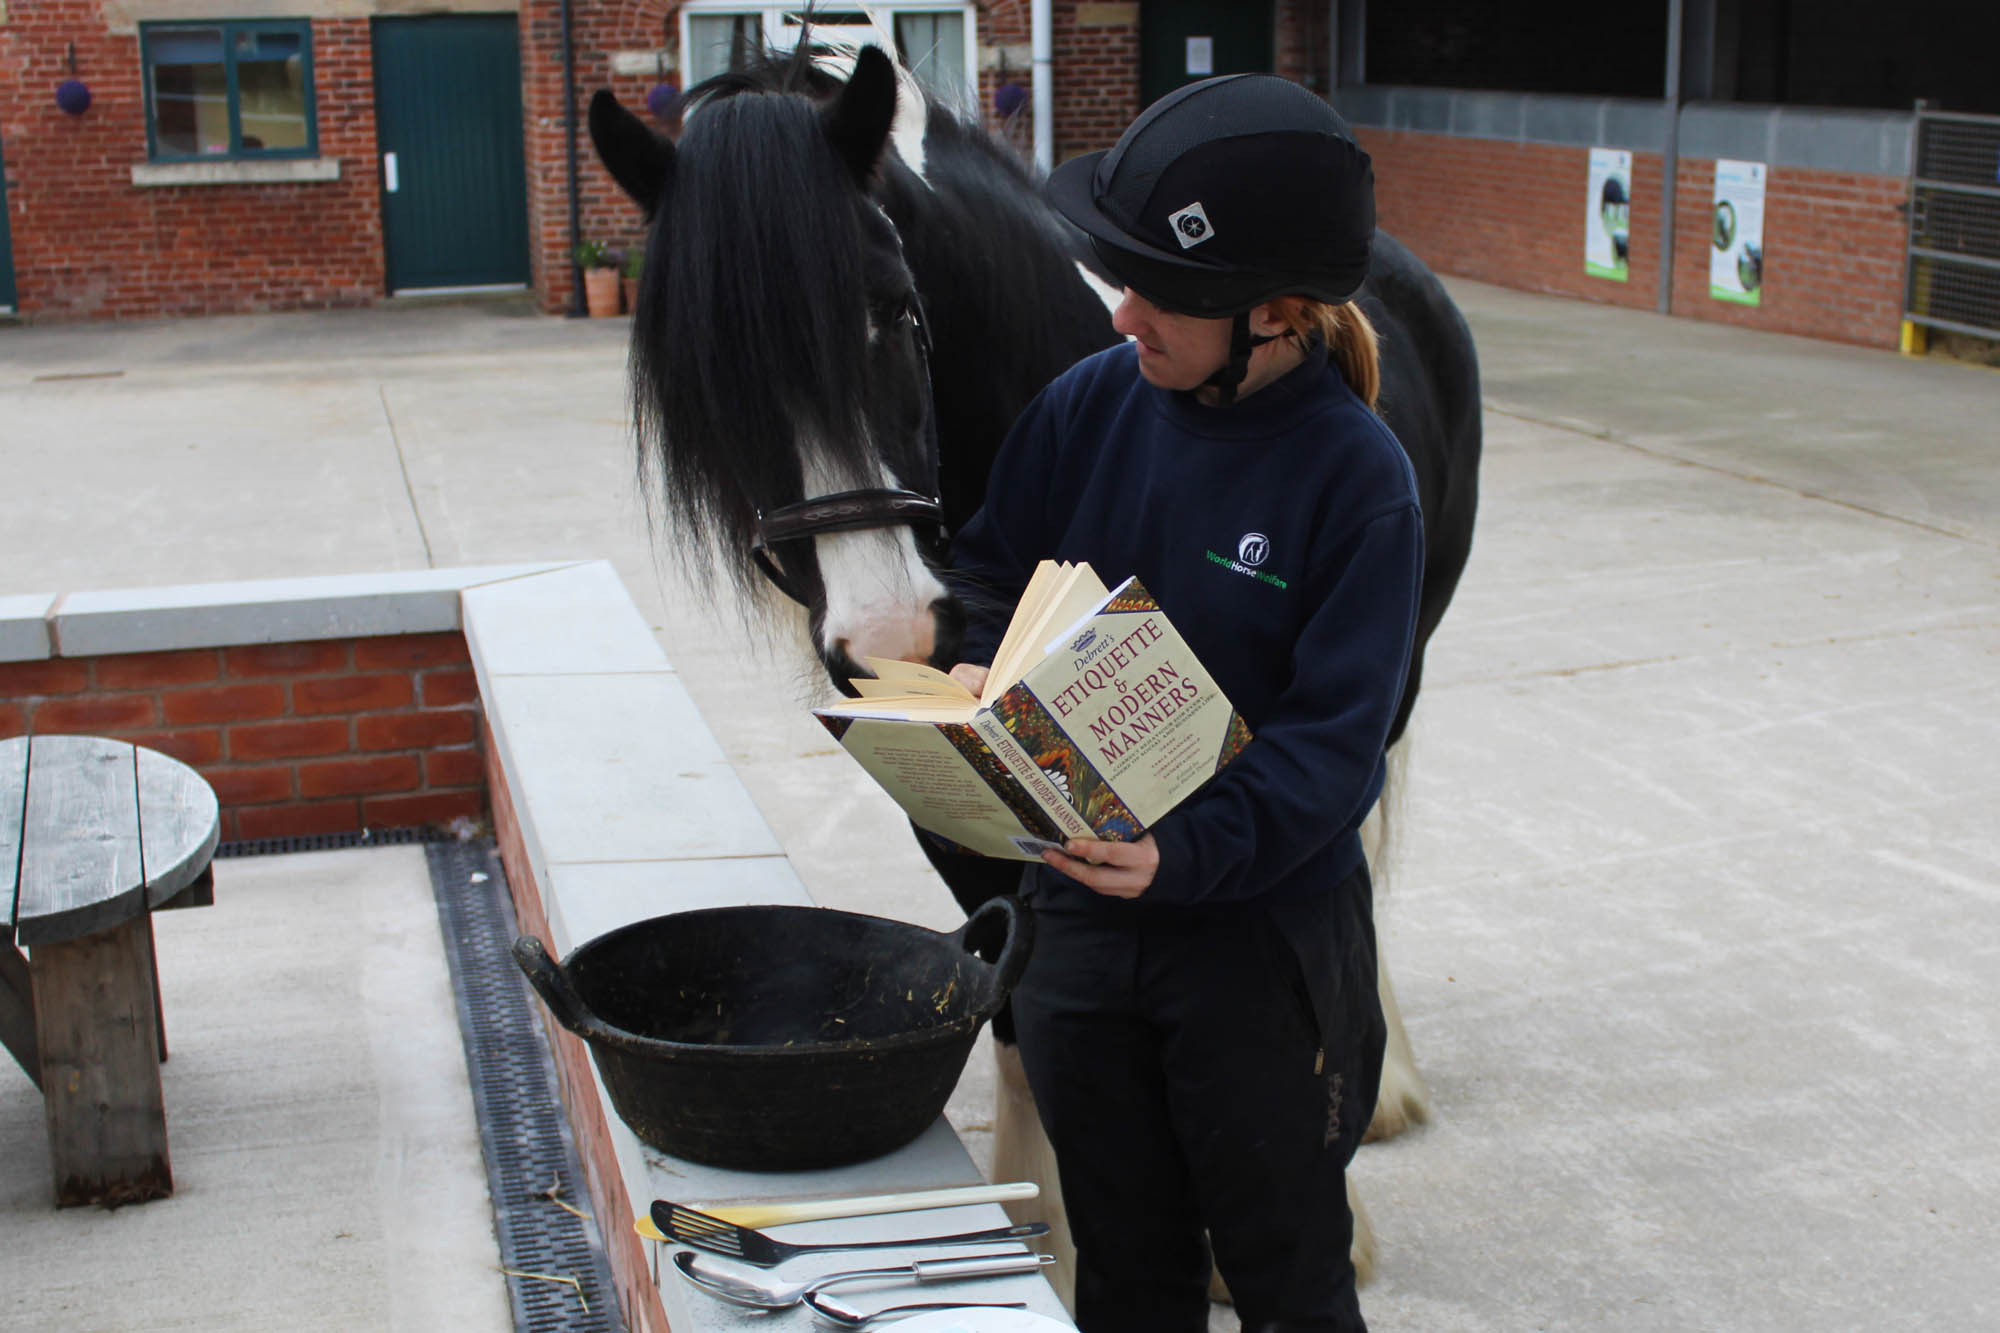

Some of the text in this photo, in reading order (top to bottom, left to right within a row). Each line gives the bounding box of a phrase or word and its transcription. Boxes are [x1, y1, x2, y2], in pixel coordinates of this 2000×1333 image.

[1051, 618, 1163, 718] ETIQUETTE
[1073, 634, 1115, 671] Debrett's
[1114, 679, 1128, 693] &
[1088, 660, 1180, 743] MODERN
[1099, 677, 1198, 766] MANNERS
[996, 739, 1032, 776] ETIQUETTE
[1029, 778, 1057, 807] MODERN
[1052, 804, 1083, 834] MANNERS
